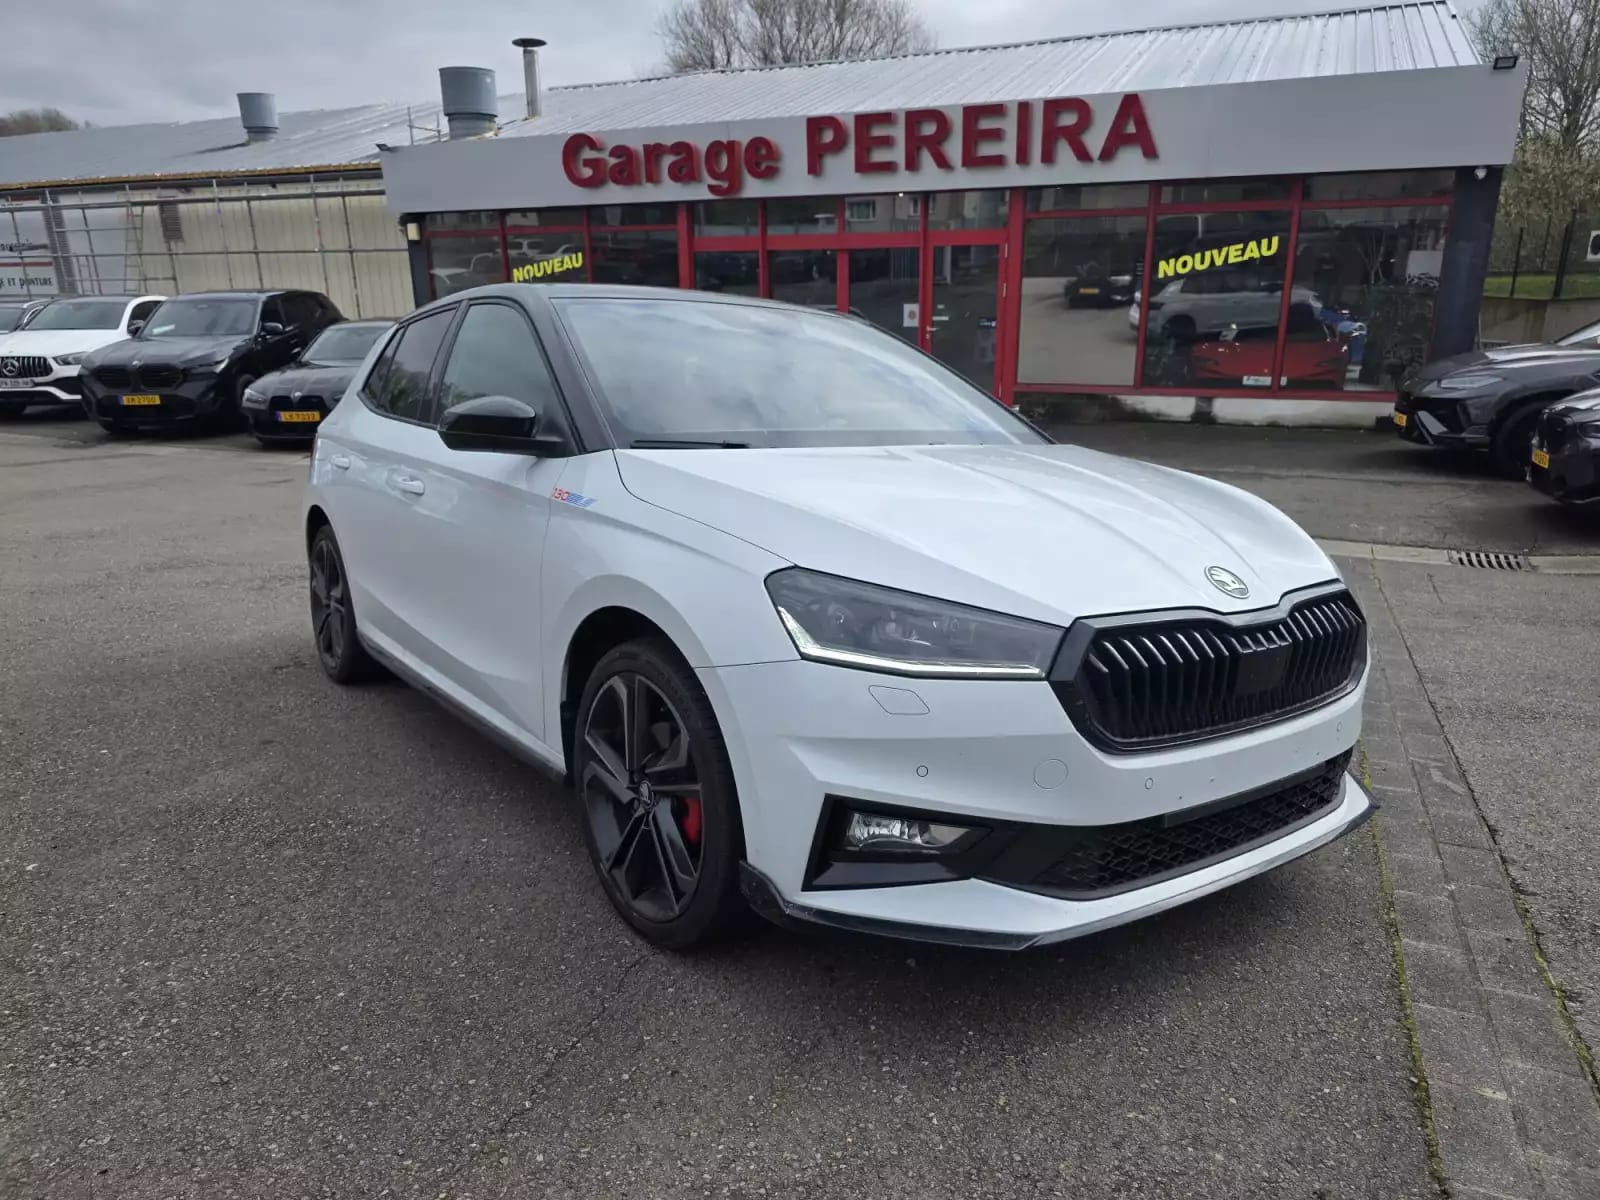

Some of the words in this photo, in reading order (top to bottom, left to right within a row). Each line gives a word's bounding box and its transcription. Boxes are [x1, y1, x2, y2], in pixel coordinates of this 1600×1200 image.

[561, 132, 781, 197] Garage
[806, 92, 1160, 176] PEREIRA
[511, 251, 584, 283] NOUVEAU
[1158, 235, 1280, 279] NOUVEAU
